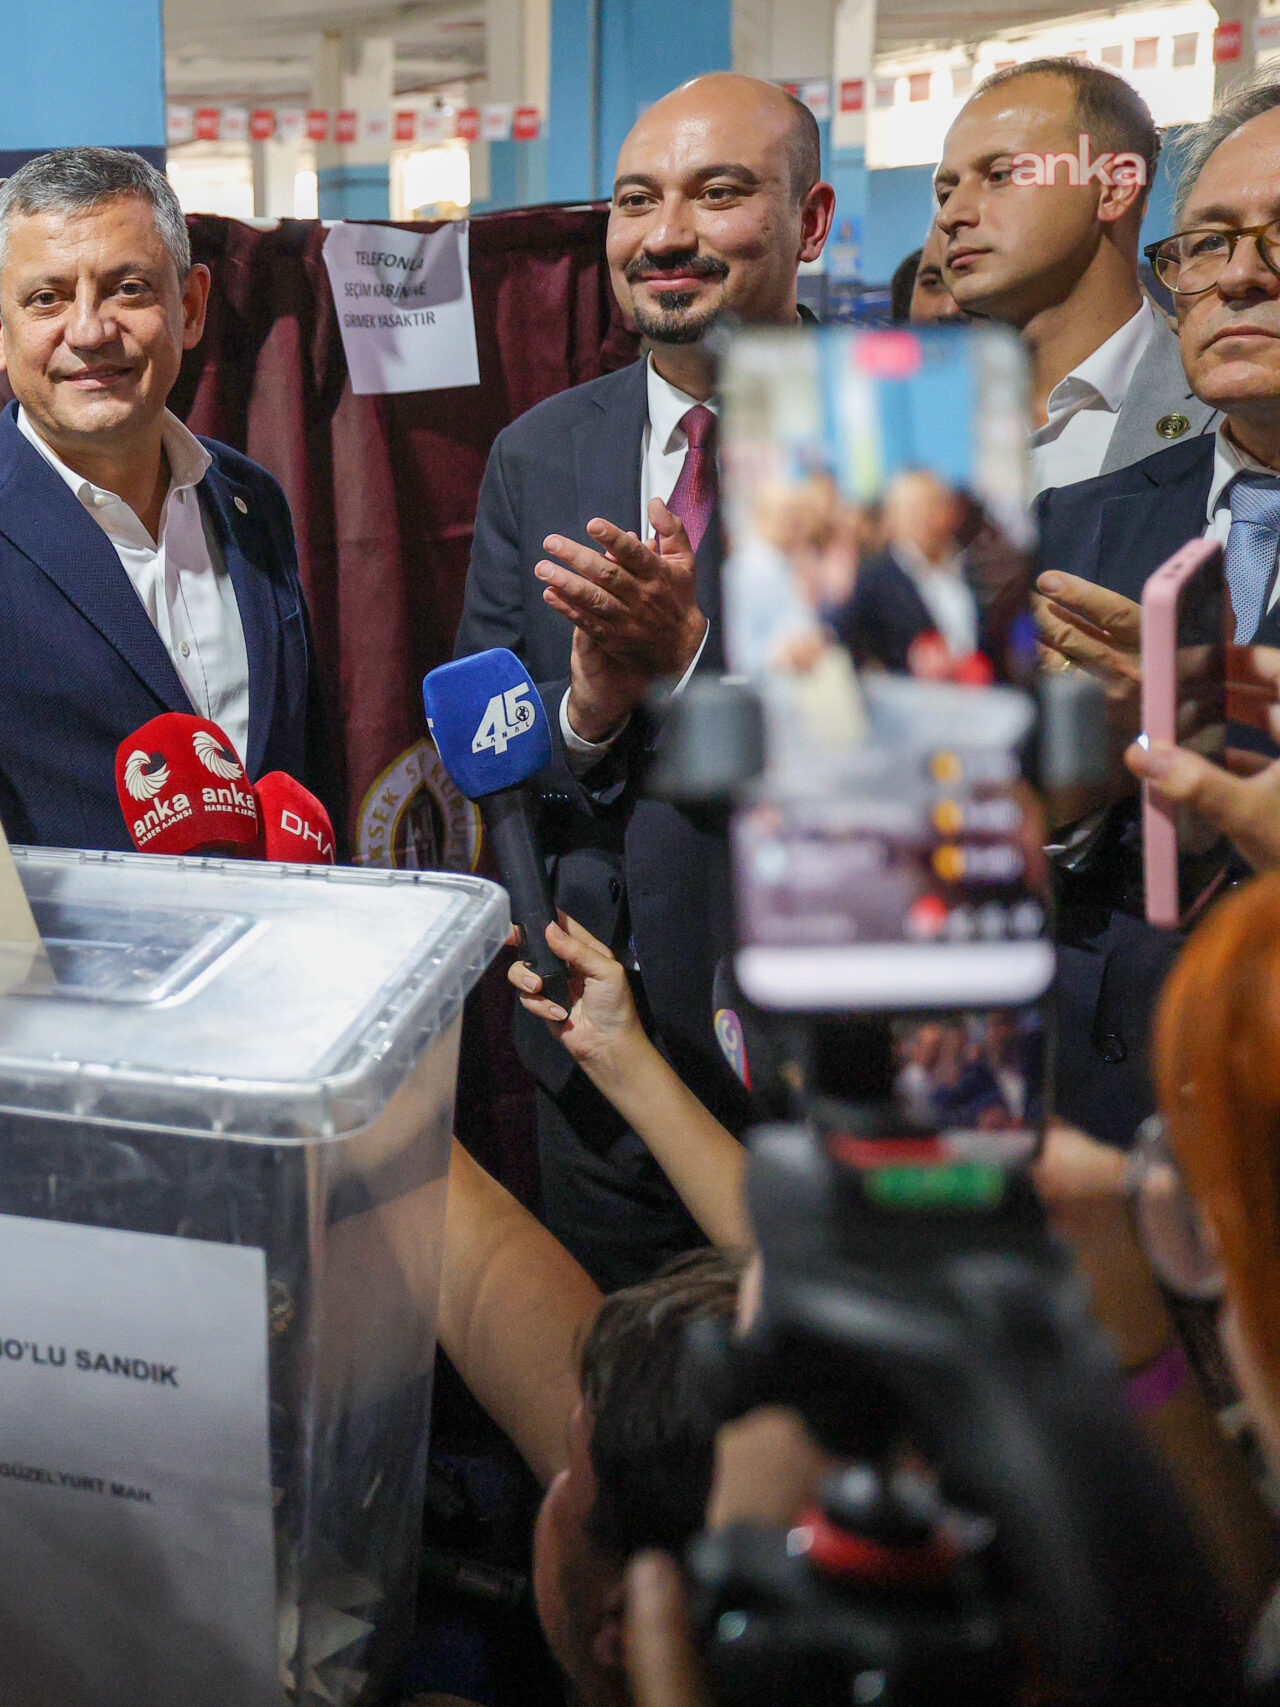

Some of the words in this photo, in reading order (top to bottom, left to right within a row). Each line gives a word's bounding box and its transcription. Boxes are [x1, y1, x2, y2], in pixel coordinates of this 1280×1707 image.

[344, 279, 372, 300] SEÇİM
[344, 310, 375, 329] GİRMEK
[377, 310, 436, 329] YASAKTIR
[201, 782, 256, 809] anka
[133, 793, 190, 838] anka
[162, 808, 193, 829] AJANSI
[204, 804, 233, 812] HABER
[75, 1349, 179, 1387] SANDIK
